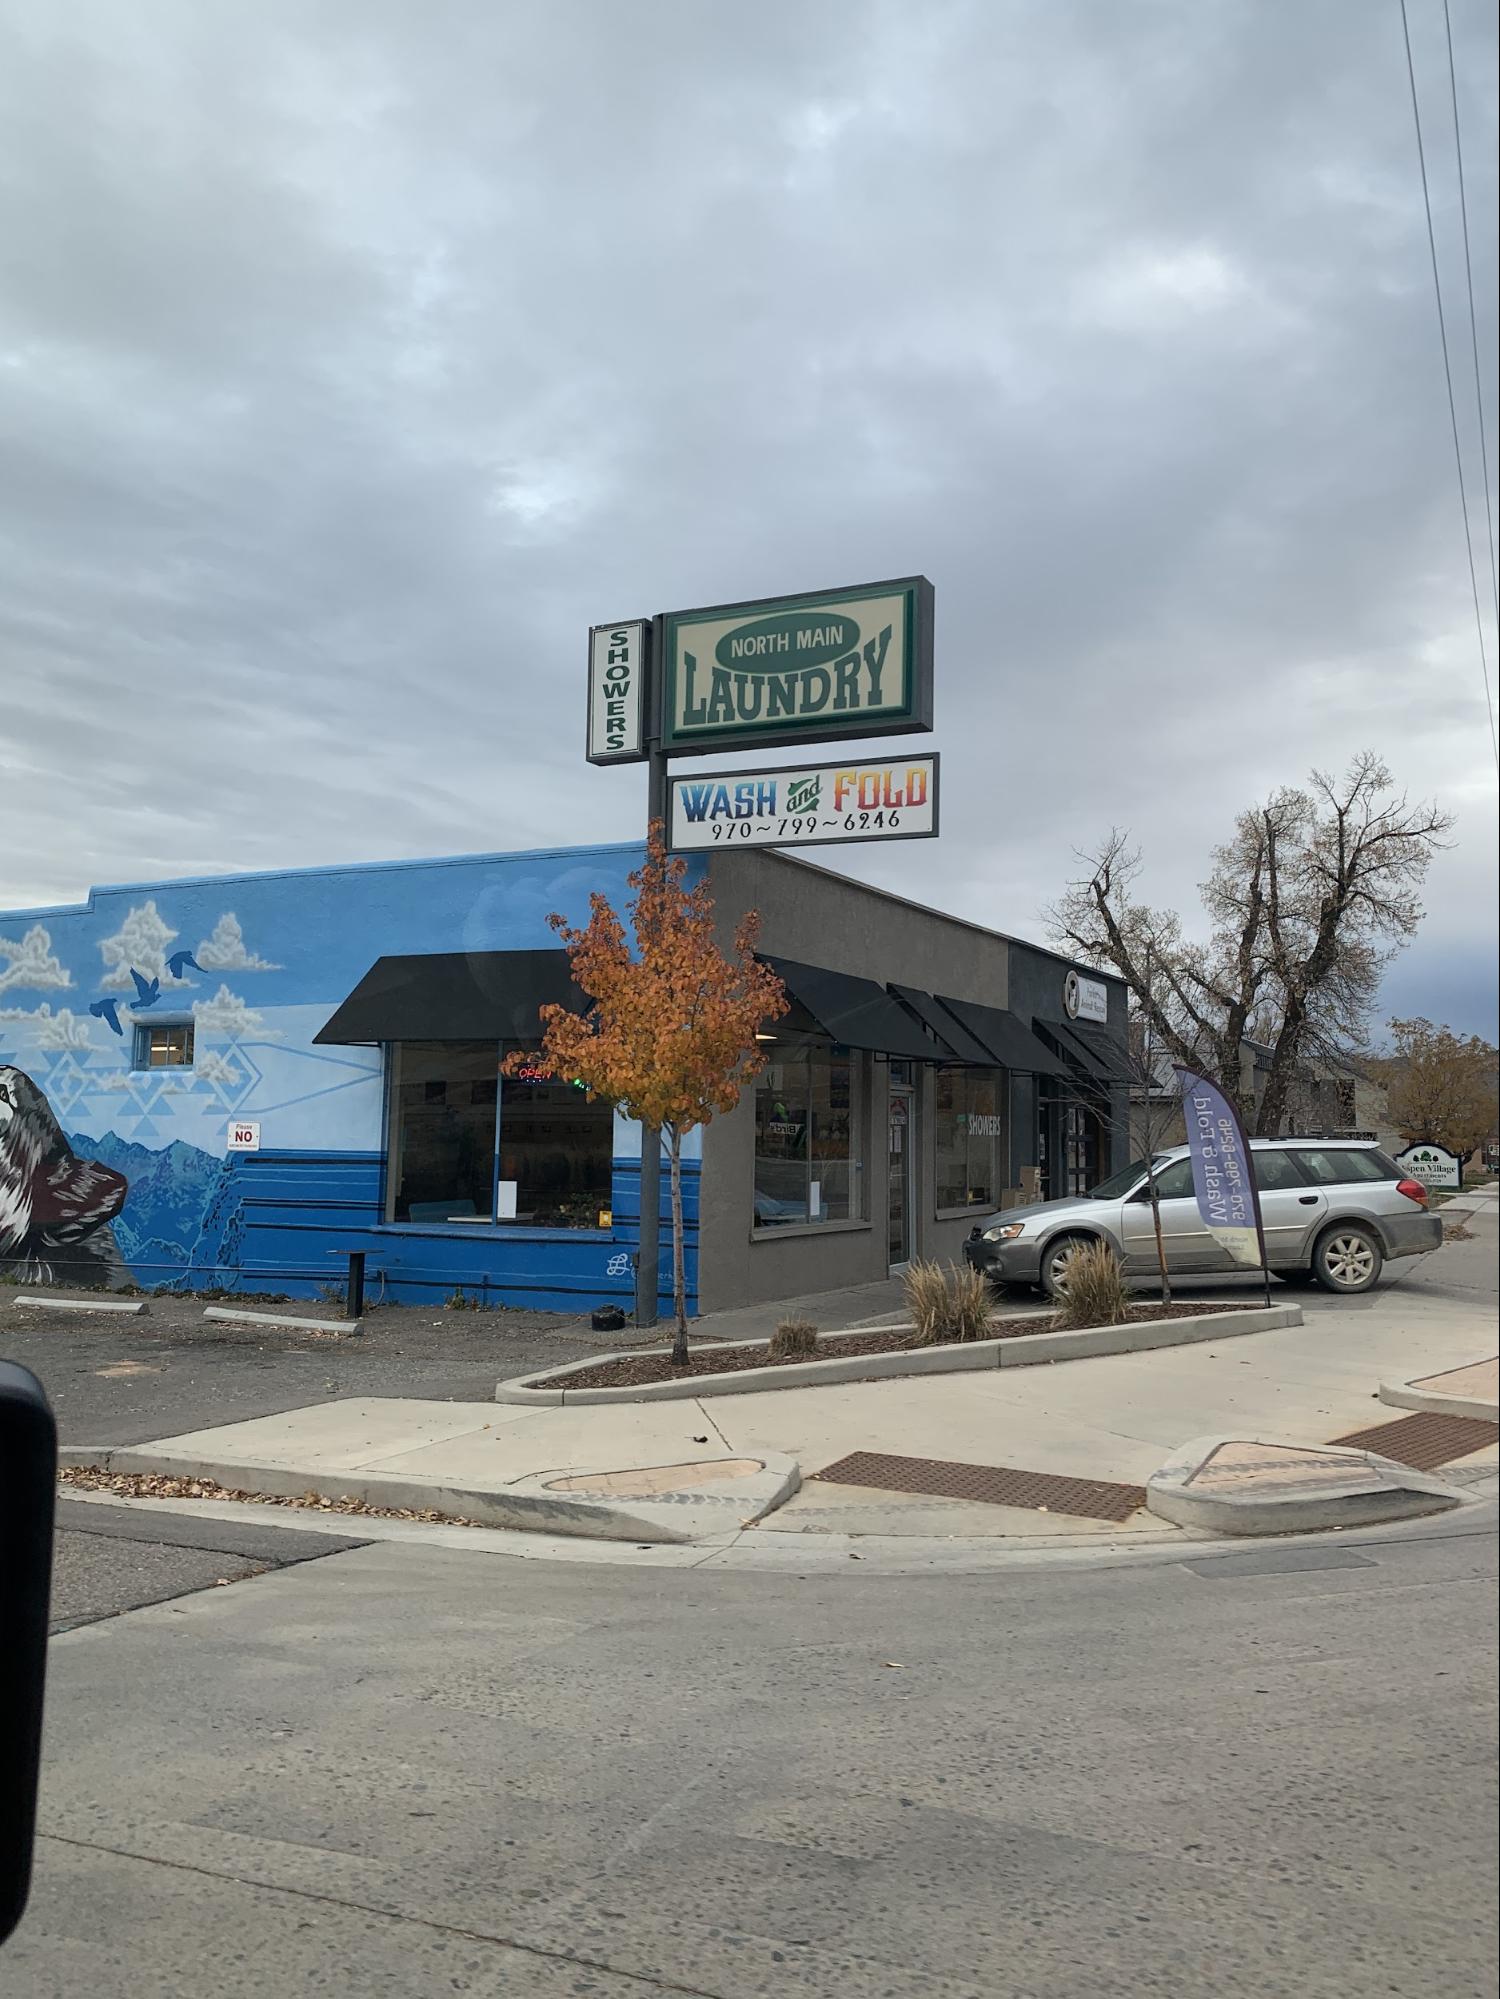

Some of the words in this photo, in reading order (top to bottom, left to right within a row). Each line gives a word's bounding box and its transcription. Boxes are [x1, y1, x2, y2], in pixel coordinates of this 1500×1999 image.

[731, 634, 789, 658] NORTH
[797, 625, 843, 648] MAIN
[602, 630, 631, 750] SHOWERS
[683, 624, 893, 726] LAUNDRY
[679, 780, 777, 823] WASH
[785, 774, 823, 813] and
[833, 767, 928, 812] FOLD
[235, 1131, 253, 1142] NO
[968, 1114, 1001, 1136] SHOWERS
[1402, 1164, 1425, 1173] spen
[1427, 1164, 1456, 1174] Village
